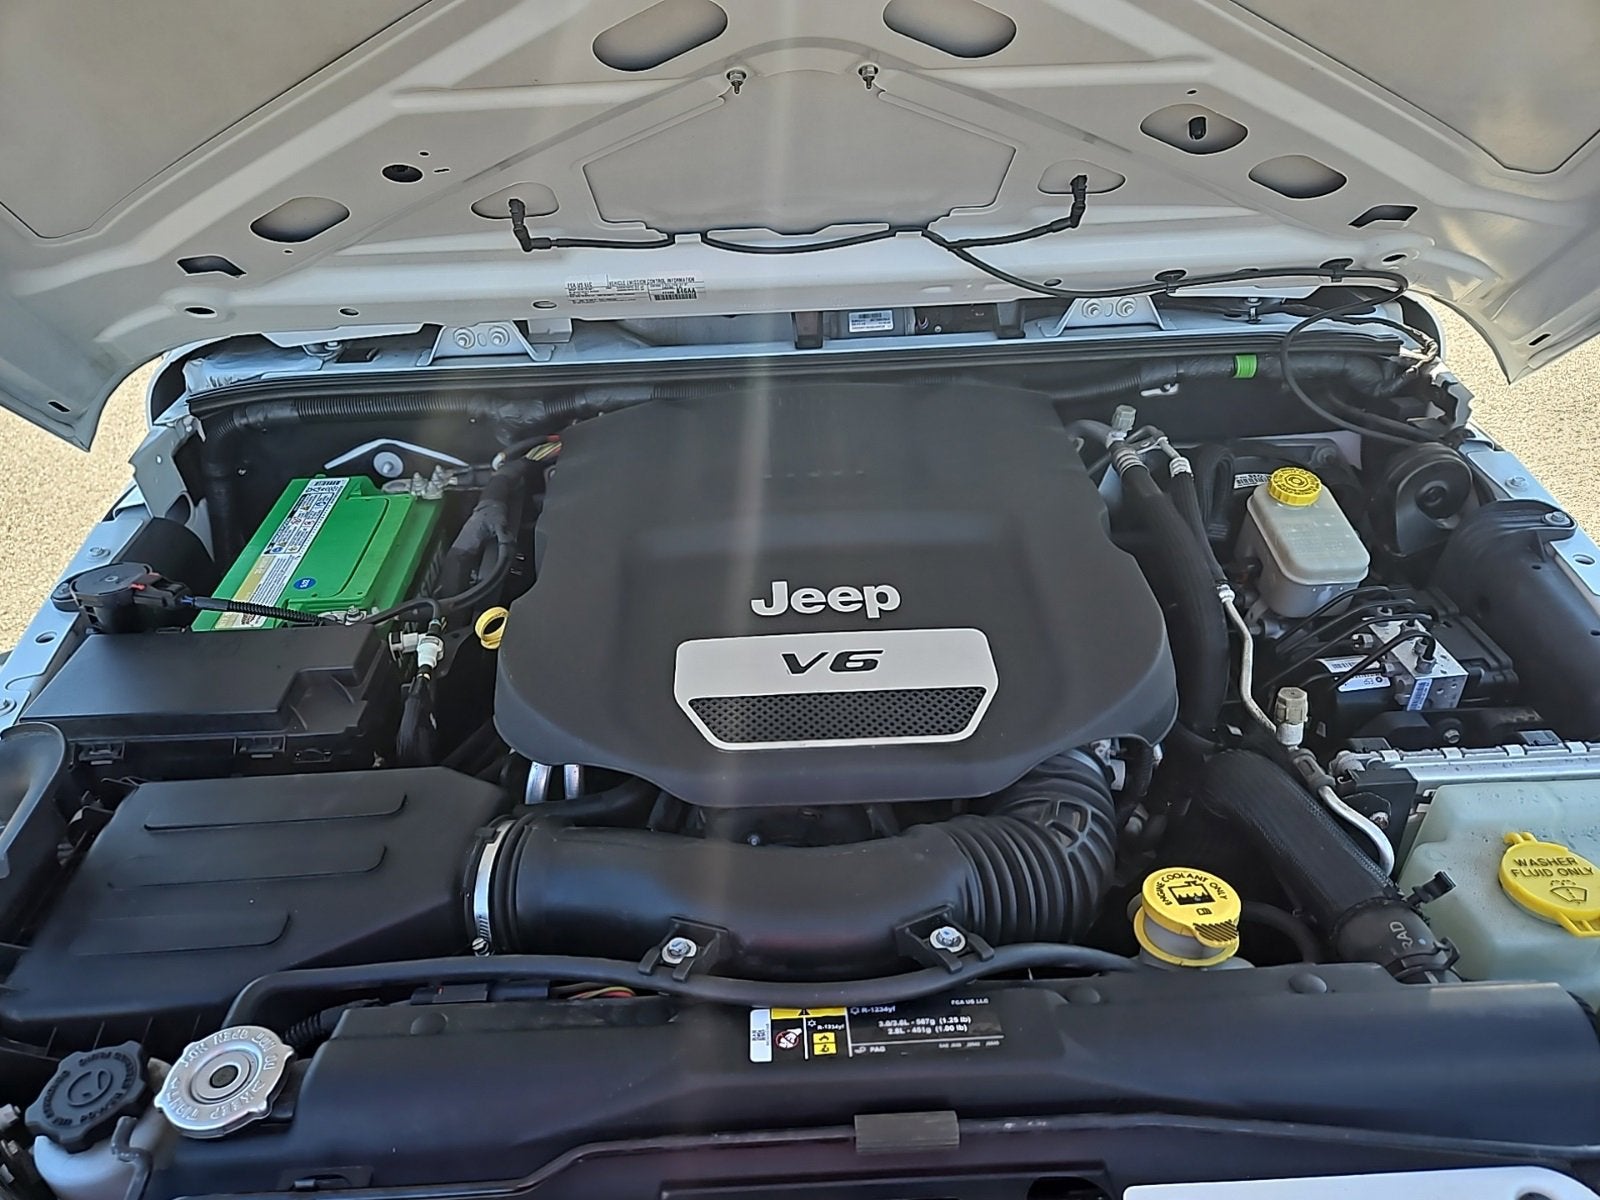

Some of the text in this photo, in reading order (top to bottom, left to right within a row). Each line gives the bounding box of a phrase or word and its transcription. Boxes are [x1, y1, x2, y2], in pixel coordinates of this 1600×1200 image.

[751, 580, 901, 619] Jeep
[781, 650, 884, 675] V6
[1511, 868, 1594, 877] FLUID ONLY
[1514, 857, 1578, 867] WASHER
[1156, 872, 1229, 906] ENGINE COOLANT ONLY
